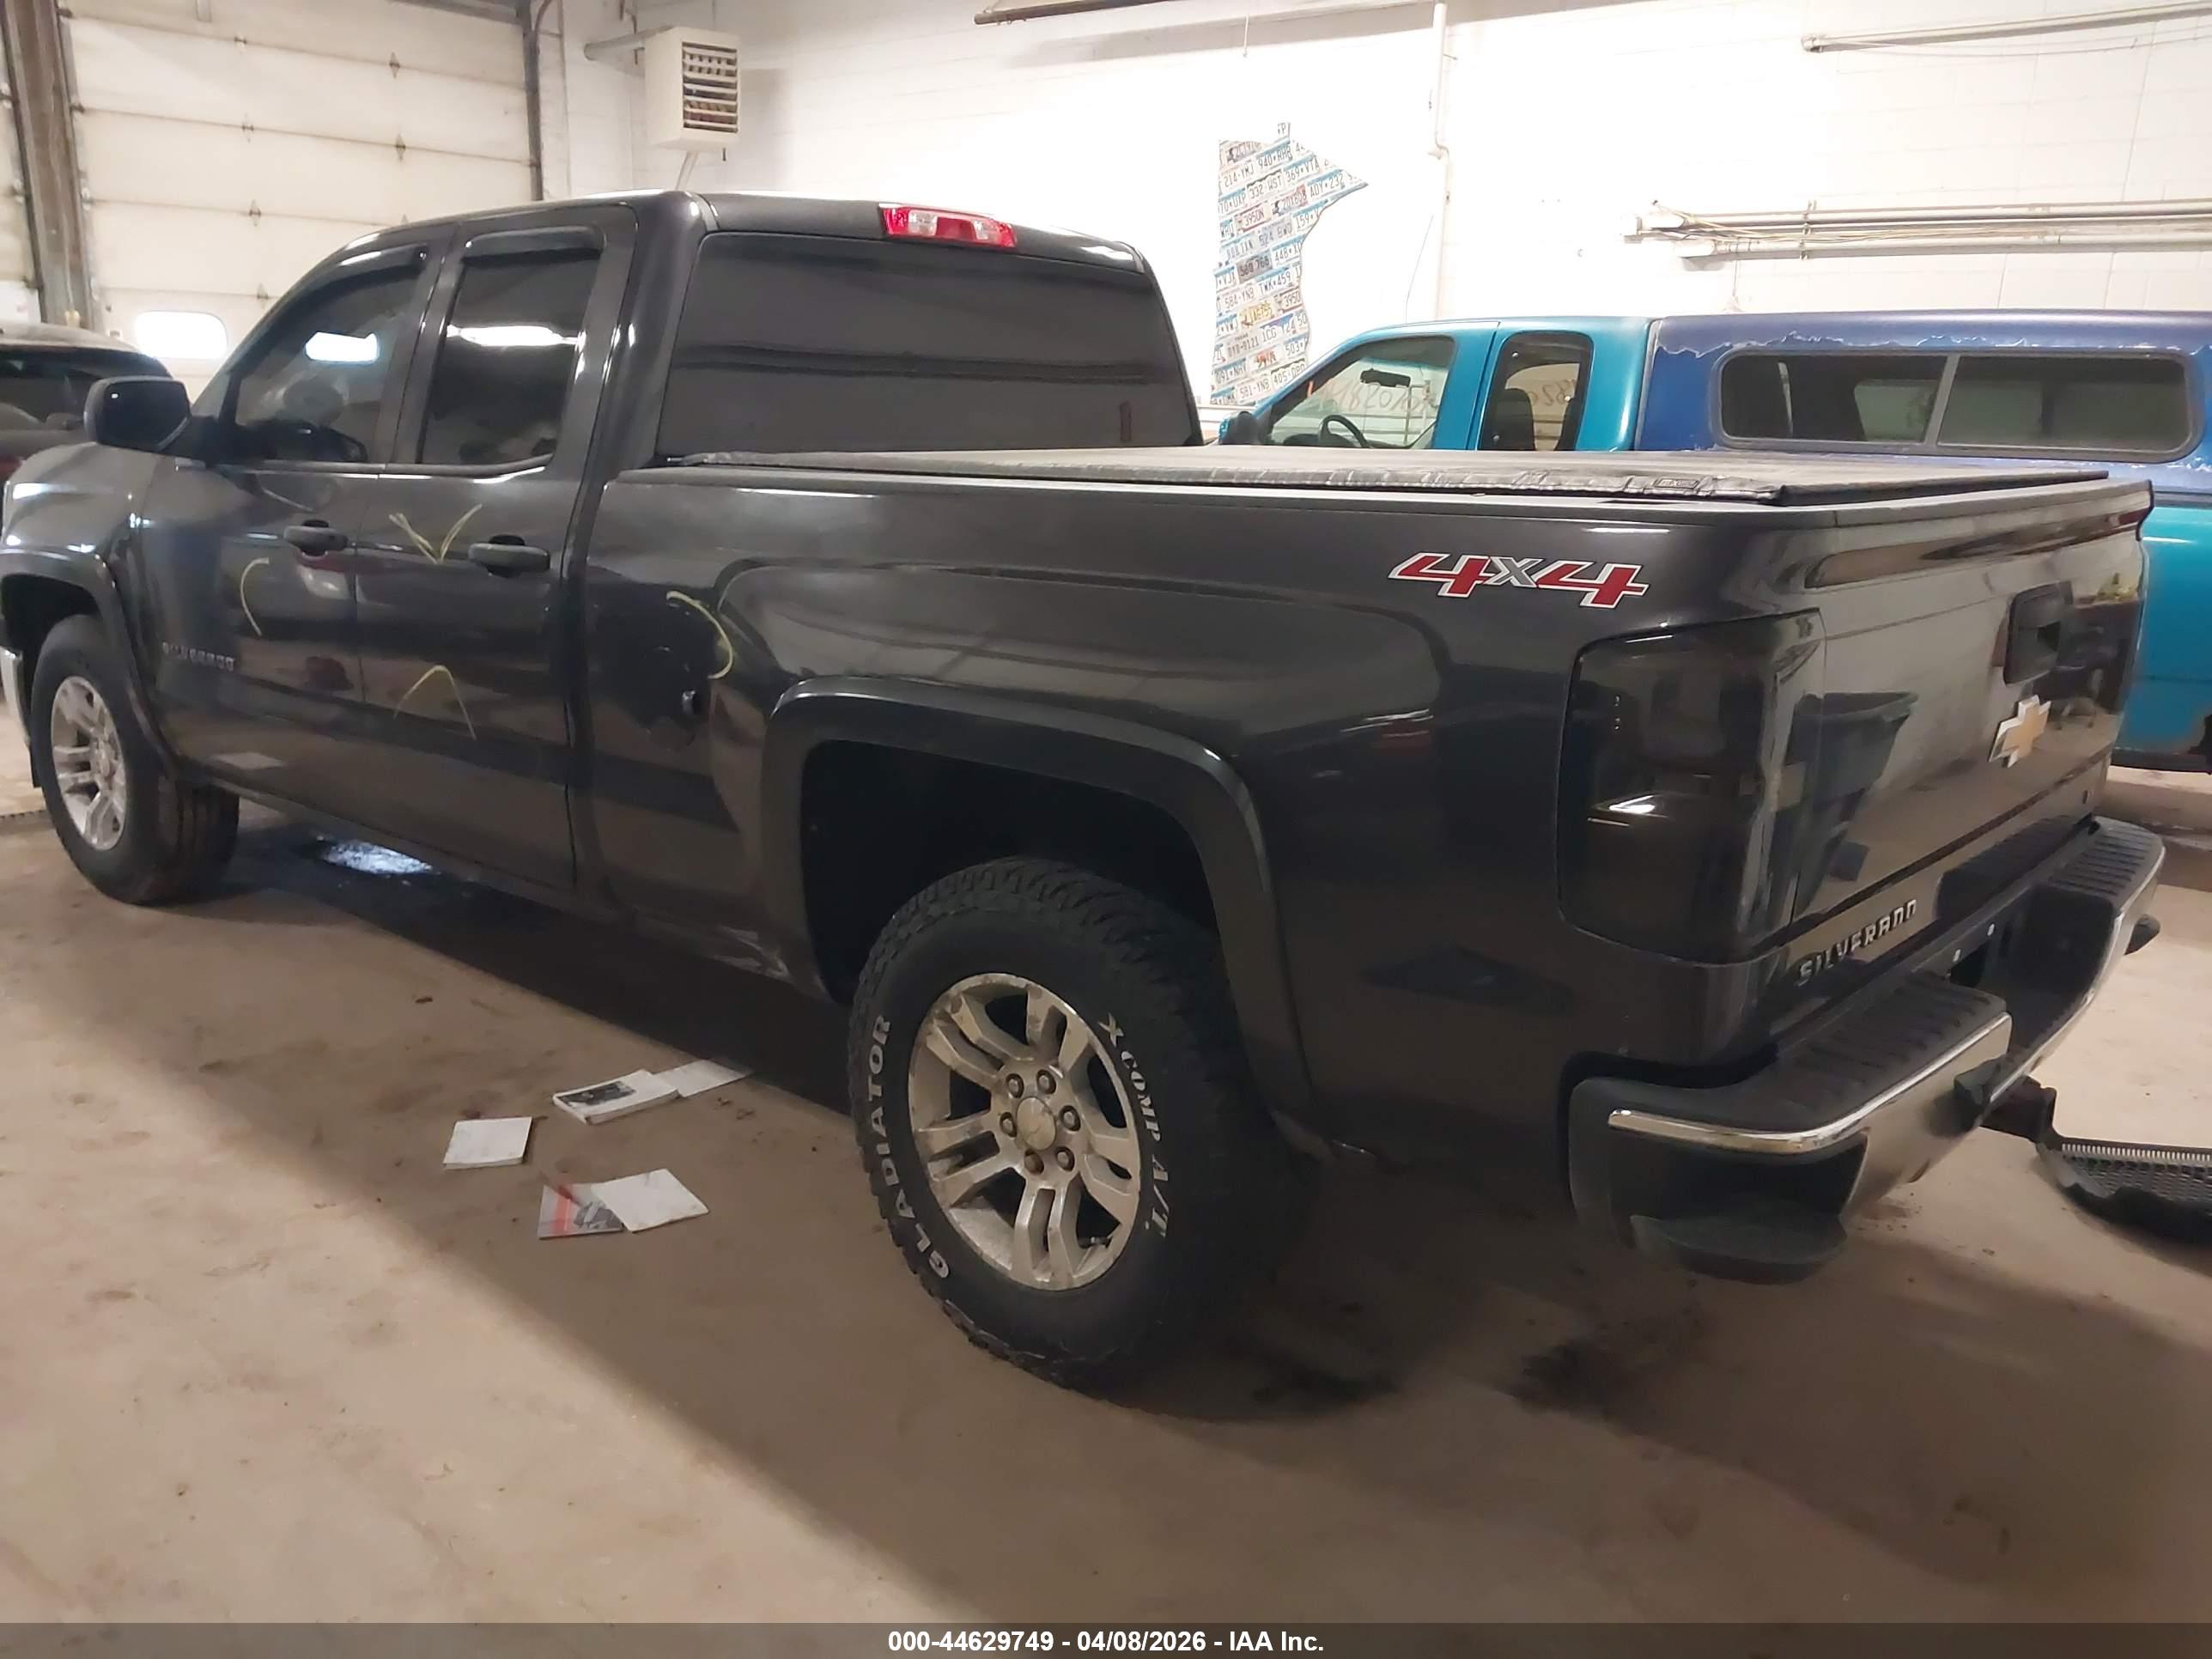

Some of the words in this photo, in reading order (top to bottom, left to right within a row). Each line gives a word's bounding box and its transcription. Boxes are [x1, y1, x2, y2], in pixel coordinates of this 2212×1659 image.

[1794, 898, 1917, 988] SILVERADO
[1120, 1049, 1163, 1143] COMP
[867, 1014, 951, 1279] GLADIATOR
